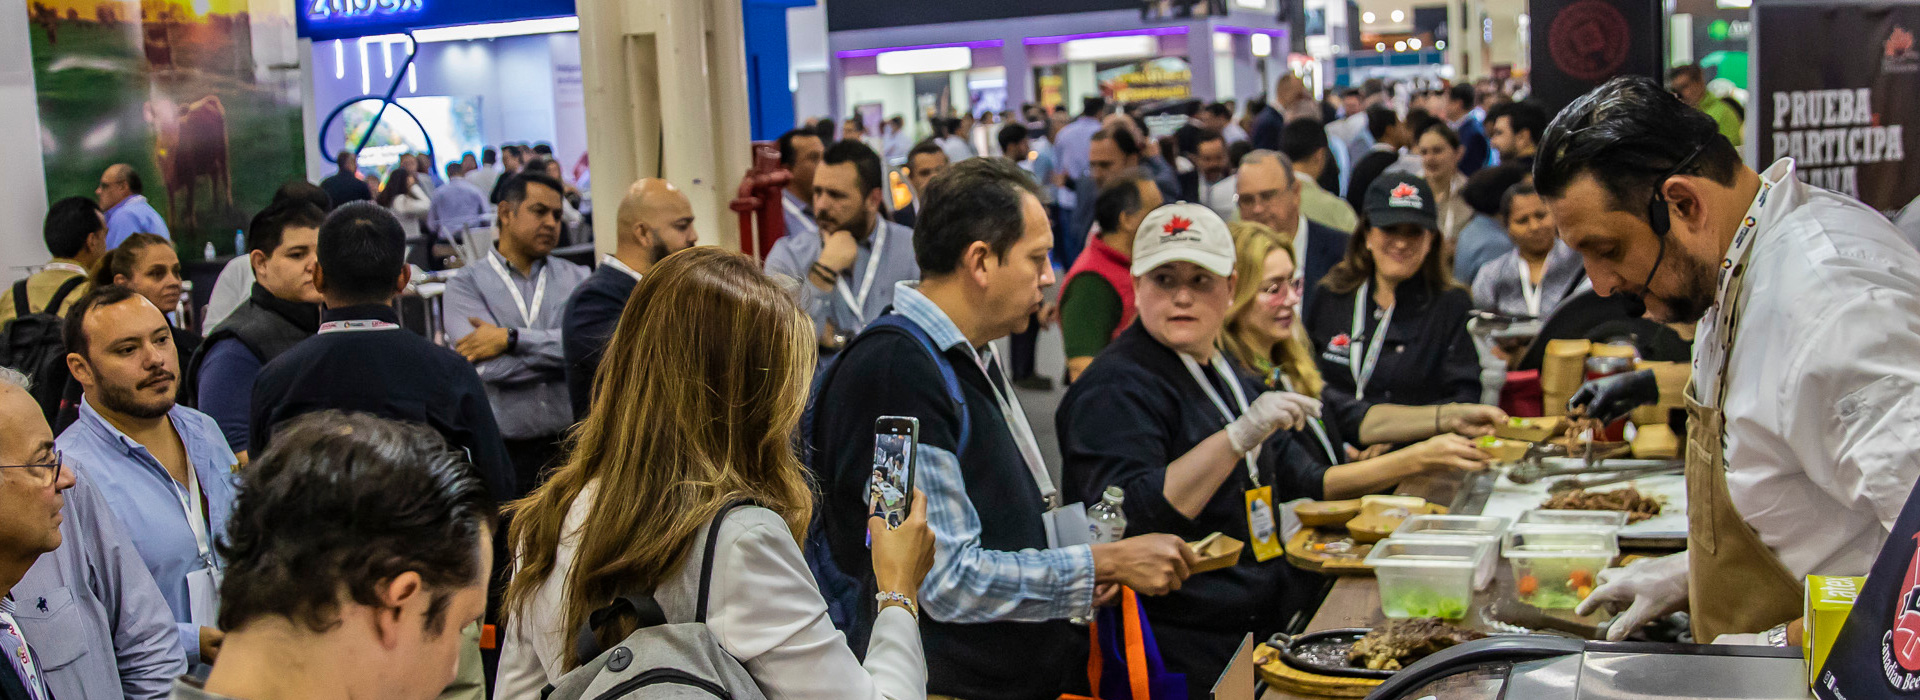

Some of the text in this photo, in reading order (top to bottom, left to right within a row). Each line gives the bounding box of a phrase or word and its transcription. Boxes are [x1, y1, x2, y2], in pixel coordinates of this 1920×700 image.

[1772, 124, 1904, 168] PARTICIPA
[1820, 576, 1858, 606] Latex
[1882, 629, 1905, 689] Canadian
